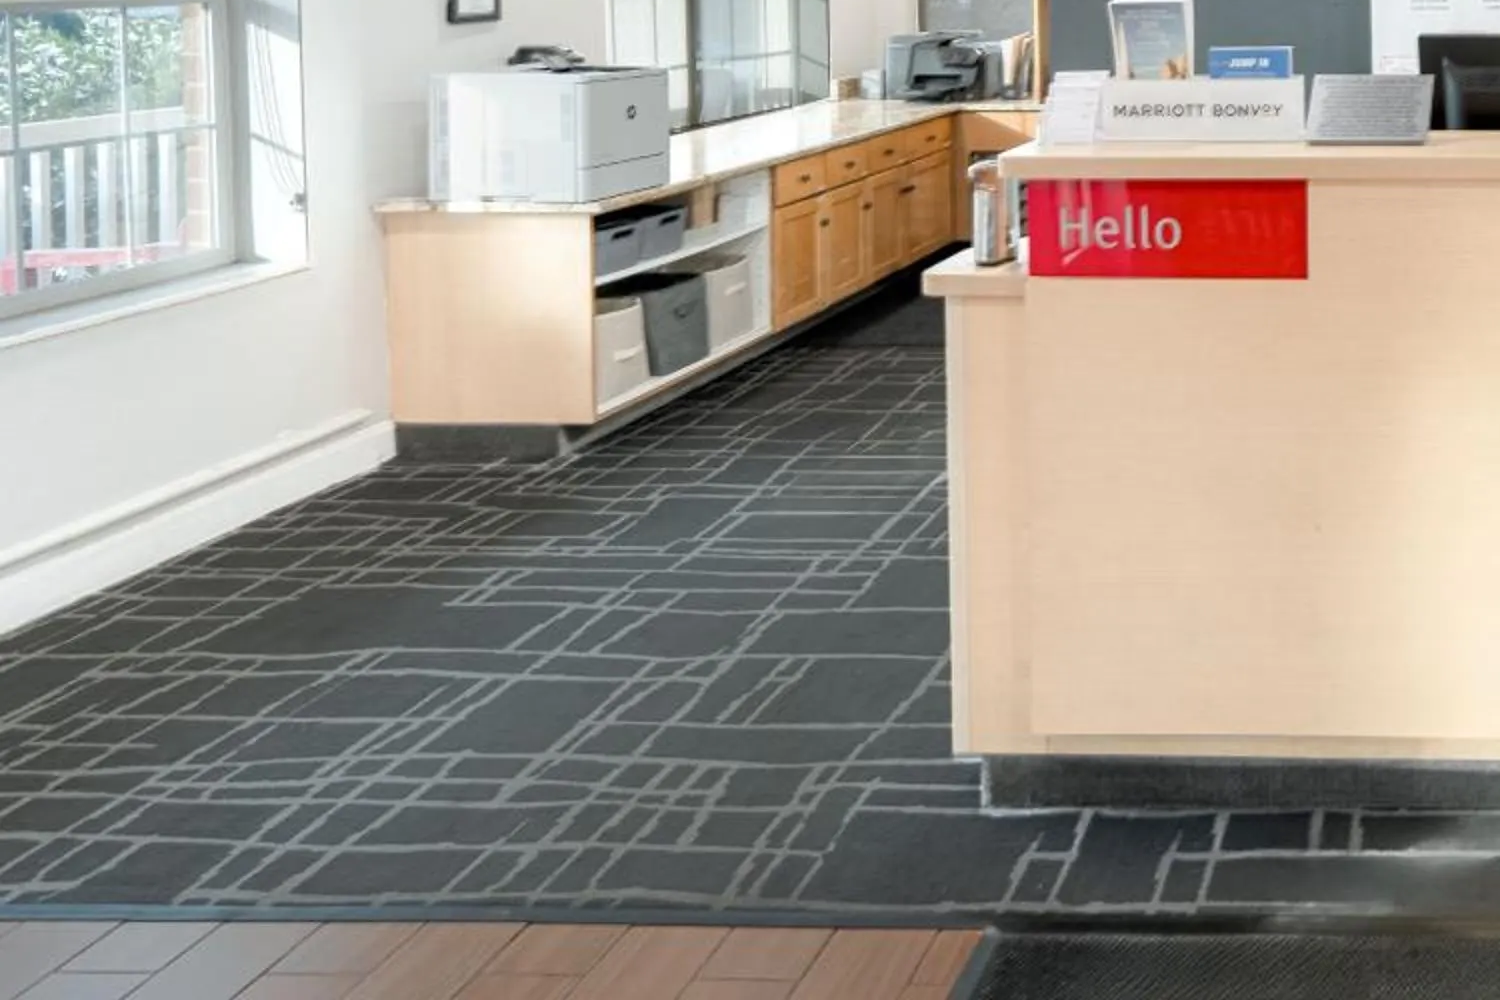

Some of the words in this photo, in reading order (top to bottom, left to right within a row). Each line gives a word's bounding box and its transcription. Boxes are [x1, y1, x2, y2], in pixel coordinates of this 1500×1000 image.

[1113, 103, 1205, 118] MARRIOTT
[1213, 103, 1283, 118] BONVOY
[1058, 204, 1183, 251] Hello
